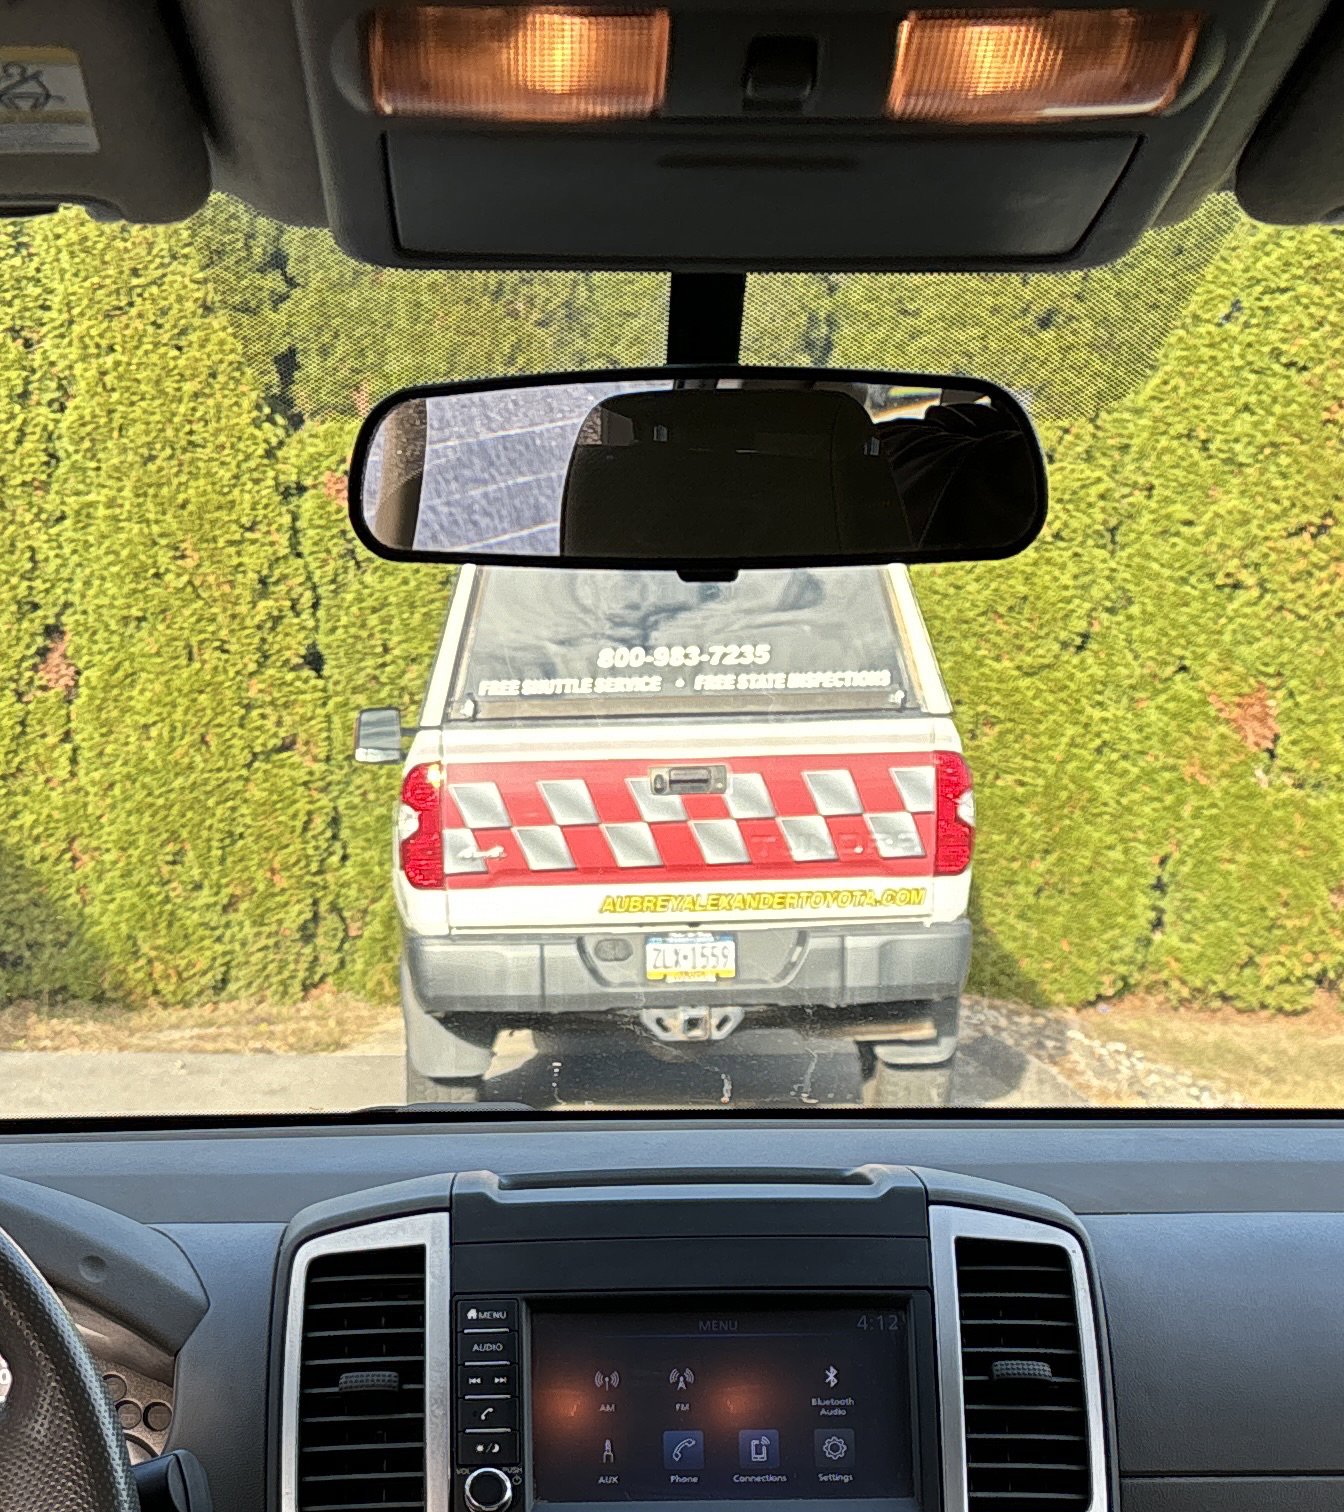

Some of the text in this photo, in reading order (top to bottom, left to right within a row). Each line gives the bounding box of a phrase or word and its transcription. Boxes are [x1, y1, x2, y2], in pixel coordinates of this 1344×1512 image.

[597, 644, 771, 668] 800-983-7235
[478, 670, 891, 696] FREE SHUTTLE SERVICE FREE STATE INSPECTIONS
[598, 887, 927, 914] AUBREYALEXANDERTOYOTA.COM
[478, 1310, 507, 1320] MENU
[698, 1320, 738, 1331] MENU
[856, 1314, 899, 1331] 4:12
[472, 1342, 504, 1352] AUDIO
[811, 1397, 855, 1407] Bluetooth
[599, 1403, 616, 1413] AM
[675, 1403, 690, 1412] FM
[819, 1407, 847, 1417] Audio
[598, 1475, 619, 1485] AUX
[670, 1474, 699, 1484] Phone
[733, 1473, 787, 1483] Connections
[817, 1473, 853, 1484] Settings
